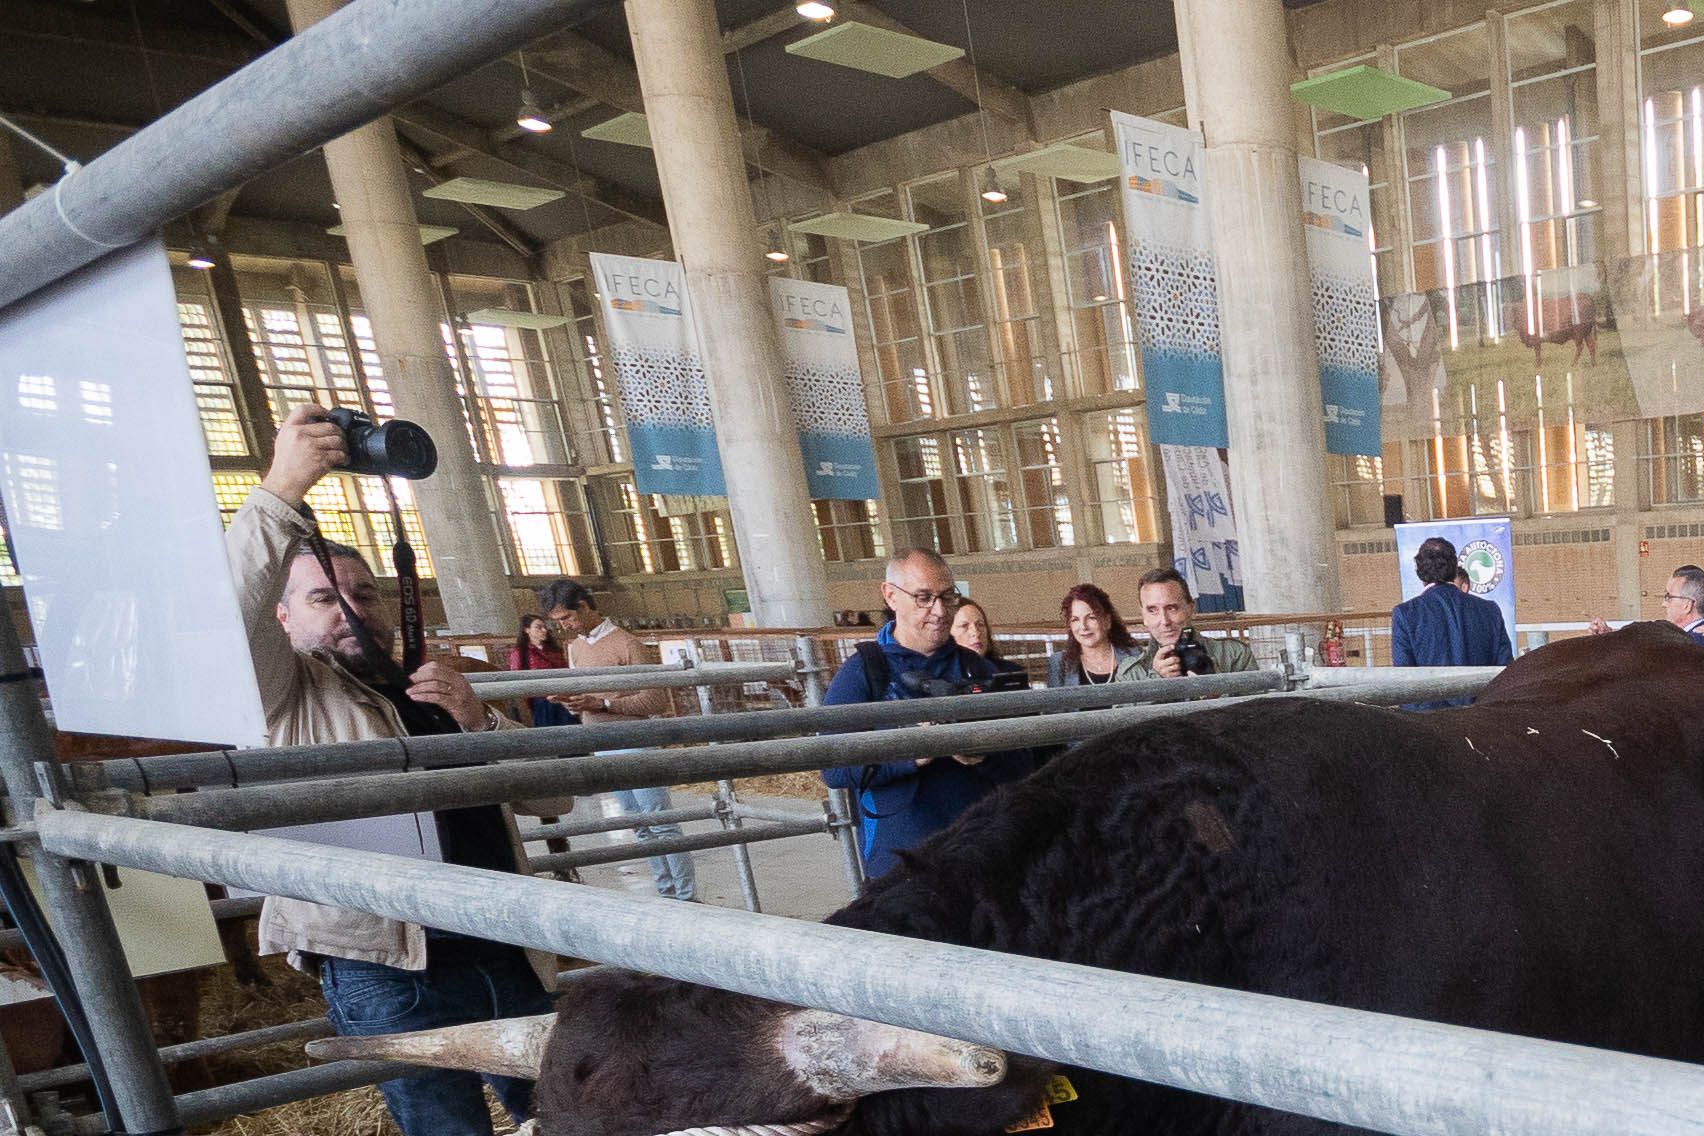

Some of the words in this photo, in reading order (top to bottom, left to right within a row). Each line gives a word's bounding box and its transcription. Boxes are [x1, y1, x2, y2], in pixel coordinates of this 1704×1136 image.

[1124, 139, 1197, 181] IFECA
[604, 273, 681, 300] IFECA
[402, 576, 415, 606] EOS
